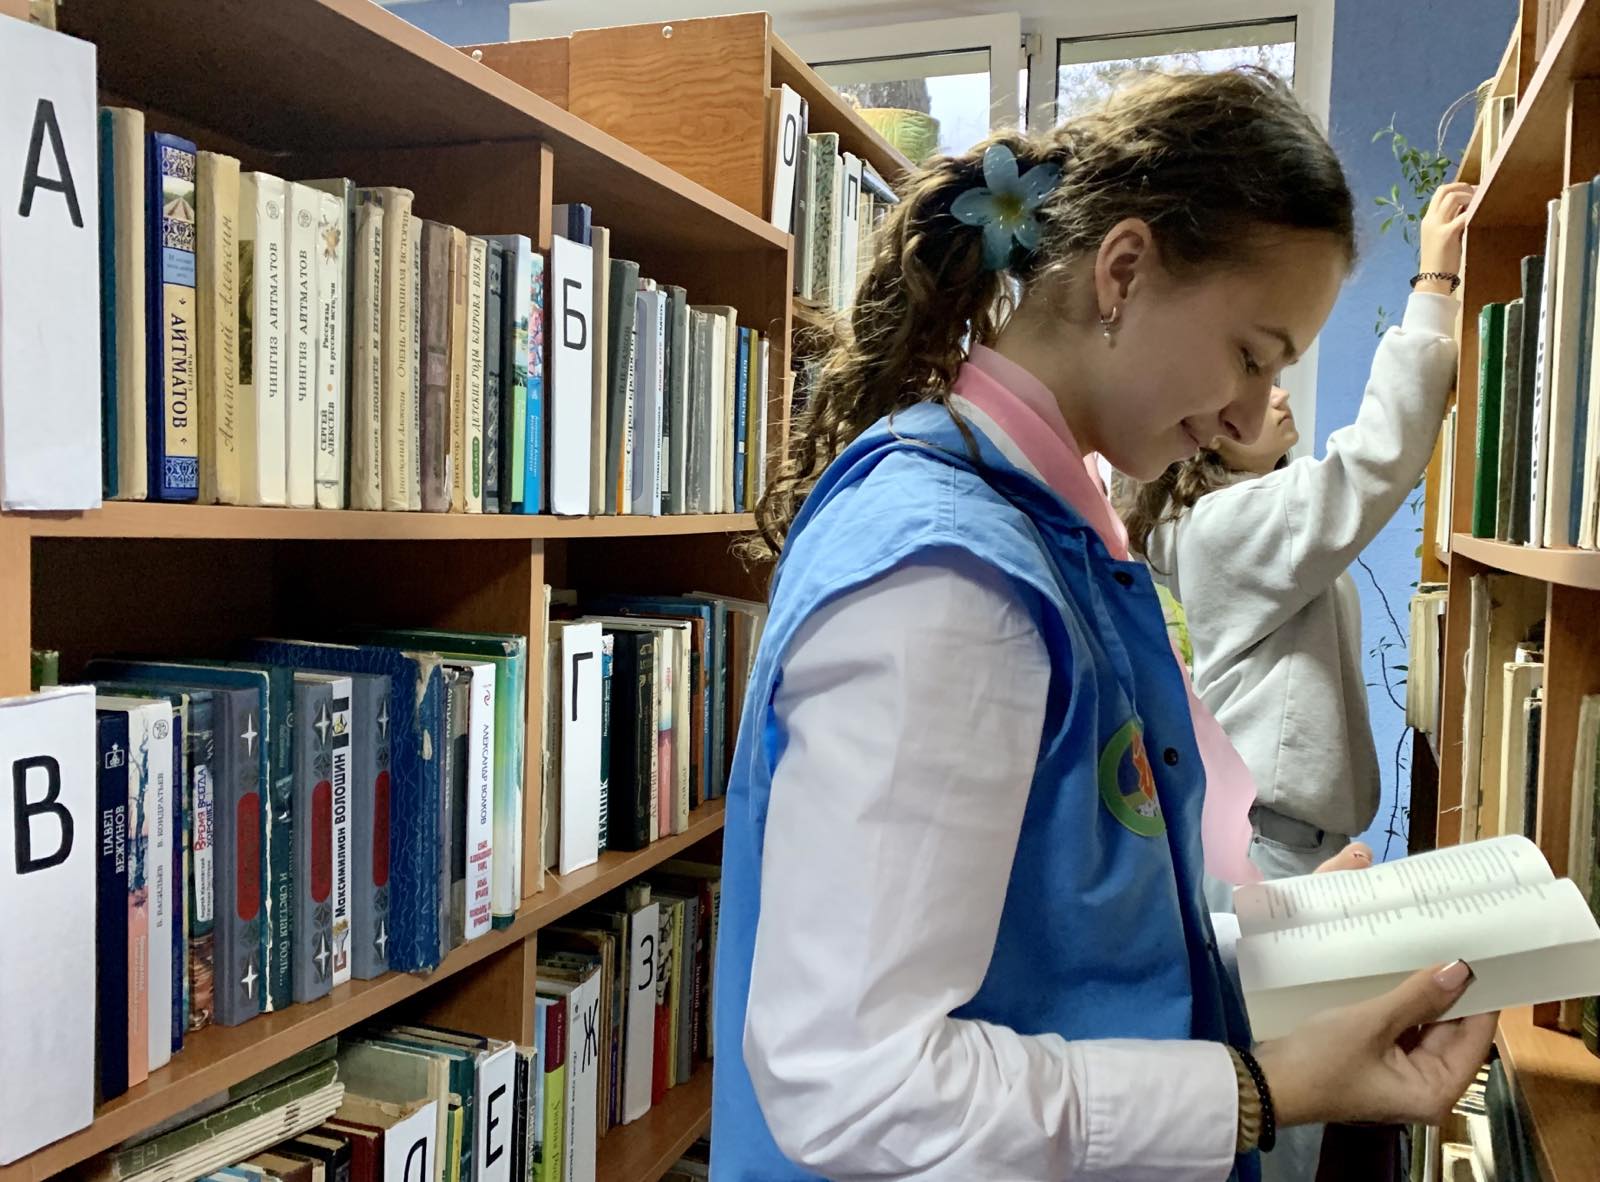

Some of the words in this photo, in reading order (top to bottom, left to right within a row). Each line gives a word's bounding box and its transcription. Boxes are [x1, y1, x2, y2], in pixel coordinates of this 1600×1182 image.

[19, 98, 83, 228] А
[847, 173, 858, 221] П
[219, 215, 234, 317] Алексин
[563, 278, 588, 351] Б
[171, 312, 188, 429] АЙТМАТОВ
[217, 321, 234, 452] Анатолий
[269, 336, 278, 398] ЧИНГИЗ
[298, 341, 308, 402] ЧИНГИЗ
[327, 401, 335, 457] АЛЕКСЕЕВ
[572, 652, 593, 722] Г
[481, 724, 489, 781] АЛЕКСАНДР
[13, 755, 74, 875] В
[156, 773, 164, 836] КОНДРАТЬЕВ
[335, 753, 346, 825] ВОЛОШИН
[480, 784, 488, 825] ВОЛКОВ
[103, 809, 113, 856] ПАВЕЛ
[115, 805, 125, 874] ВЕЖИНОВ
[280, 872, 287, 881] и
[335, 827, 346, 918] Максимилиан
[279, 885, 288, 937] светлая
[279, 940, 290, 986] боль...
[582, 998, 599, 1073] Ж
[486, 1083, 506, 1168] Е
